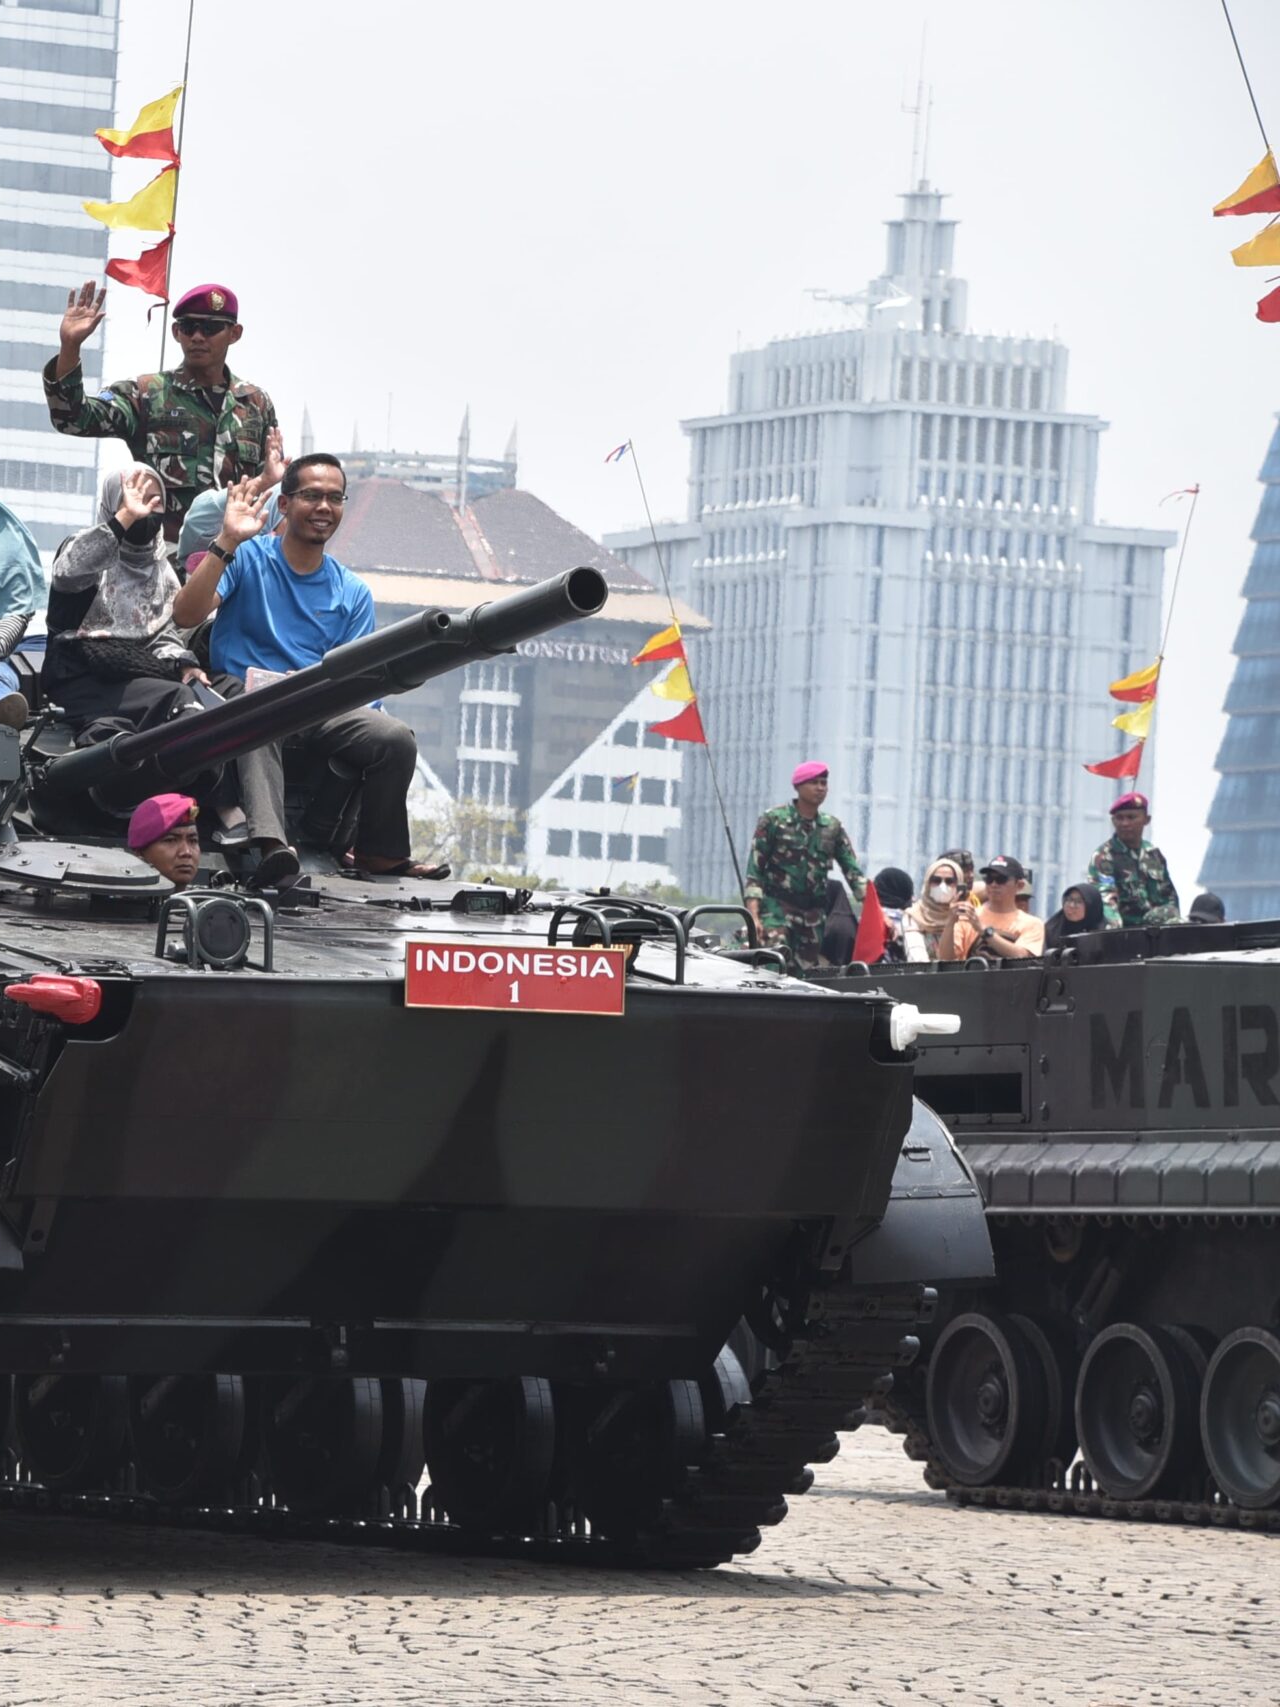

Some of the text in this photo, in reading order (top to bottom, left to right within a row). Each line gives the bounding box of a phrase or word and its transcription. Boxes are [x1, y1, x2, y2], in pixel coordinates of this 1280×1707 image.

[415, 949, 615, 979] INDONESIA
[508, 980, 520, 1004] 1
[1089, 1004, 1280, 1109] MAR
